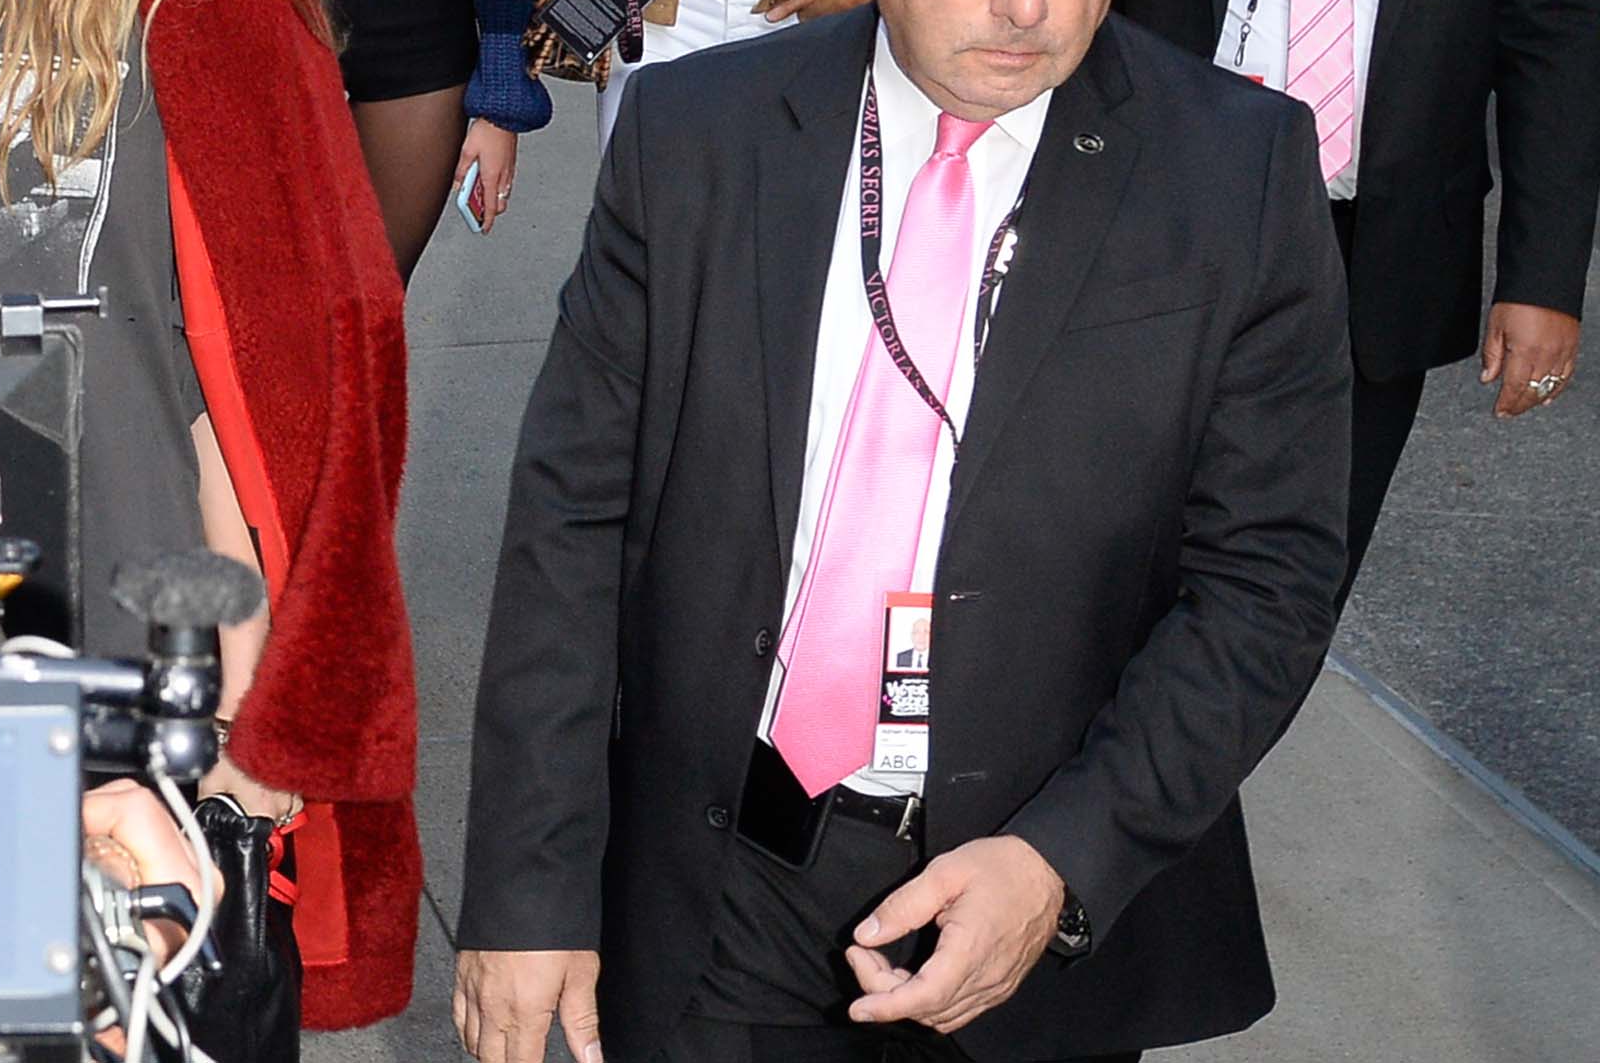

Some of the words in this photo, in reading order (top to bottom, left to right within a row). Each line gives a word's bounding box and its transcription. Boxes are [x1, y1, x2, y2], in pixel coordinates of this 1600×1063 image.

[861, 164, 881, 239] SECRET
[866, 271, 923, 391] VICTORIA'S
[880, 755, 917, 769] ABC
